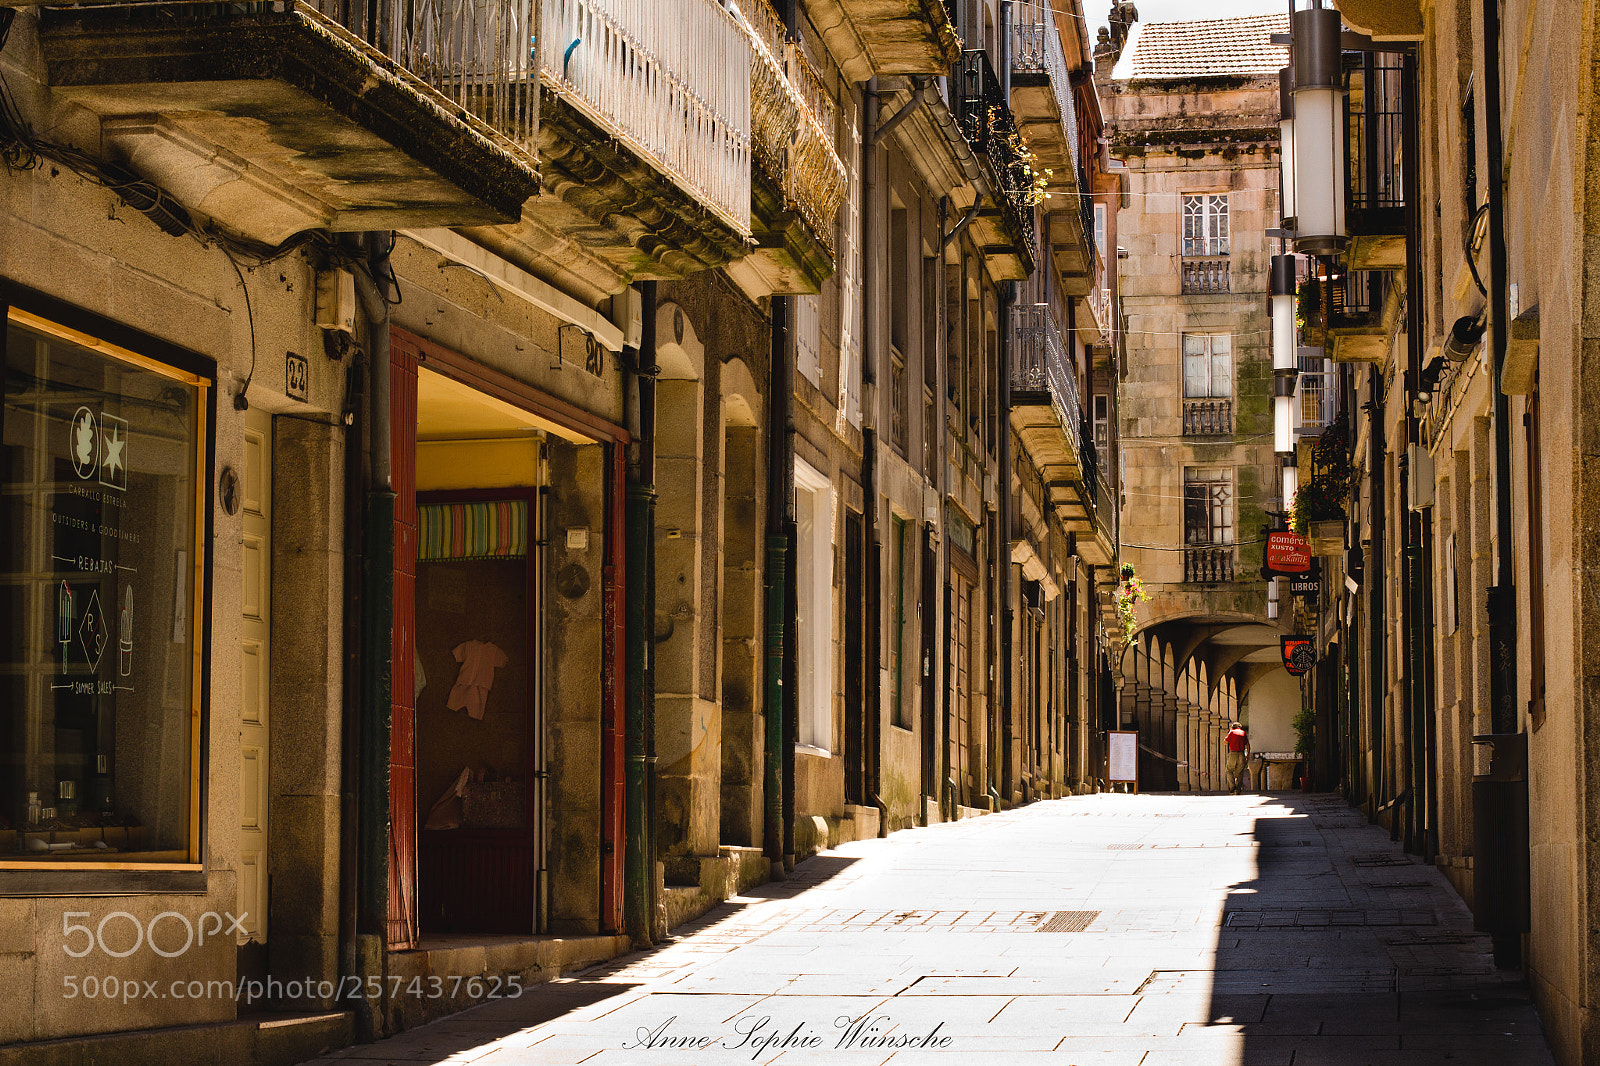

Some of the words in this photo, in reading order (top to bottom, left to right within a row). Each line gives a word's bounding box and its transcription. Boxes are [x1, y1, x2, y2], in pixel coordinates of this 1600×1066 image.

[586, 336, 603, 377] 20
[289, 360, 305, 391] 22
[52, 513, 88, 531] OUTSIDERS
[78, 555, 113, 574] REBAJAS
[1291, 582, 1319, 591] LIBROS
[87, 613, 93, 632] R
[95, 634, 100, 655] S
[75, 681, 94, 694] SUMMER
[97, 681, 112, 694] SALES
